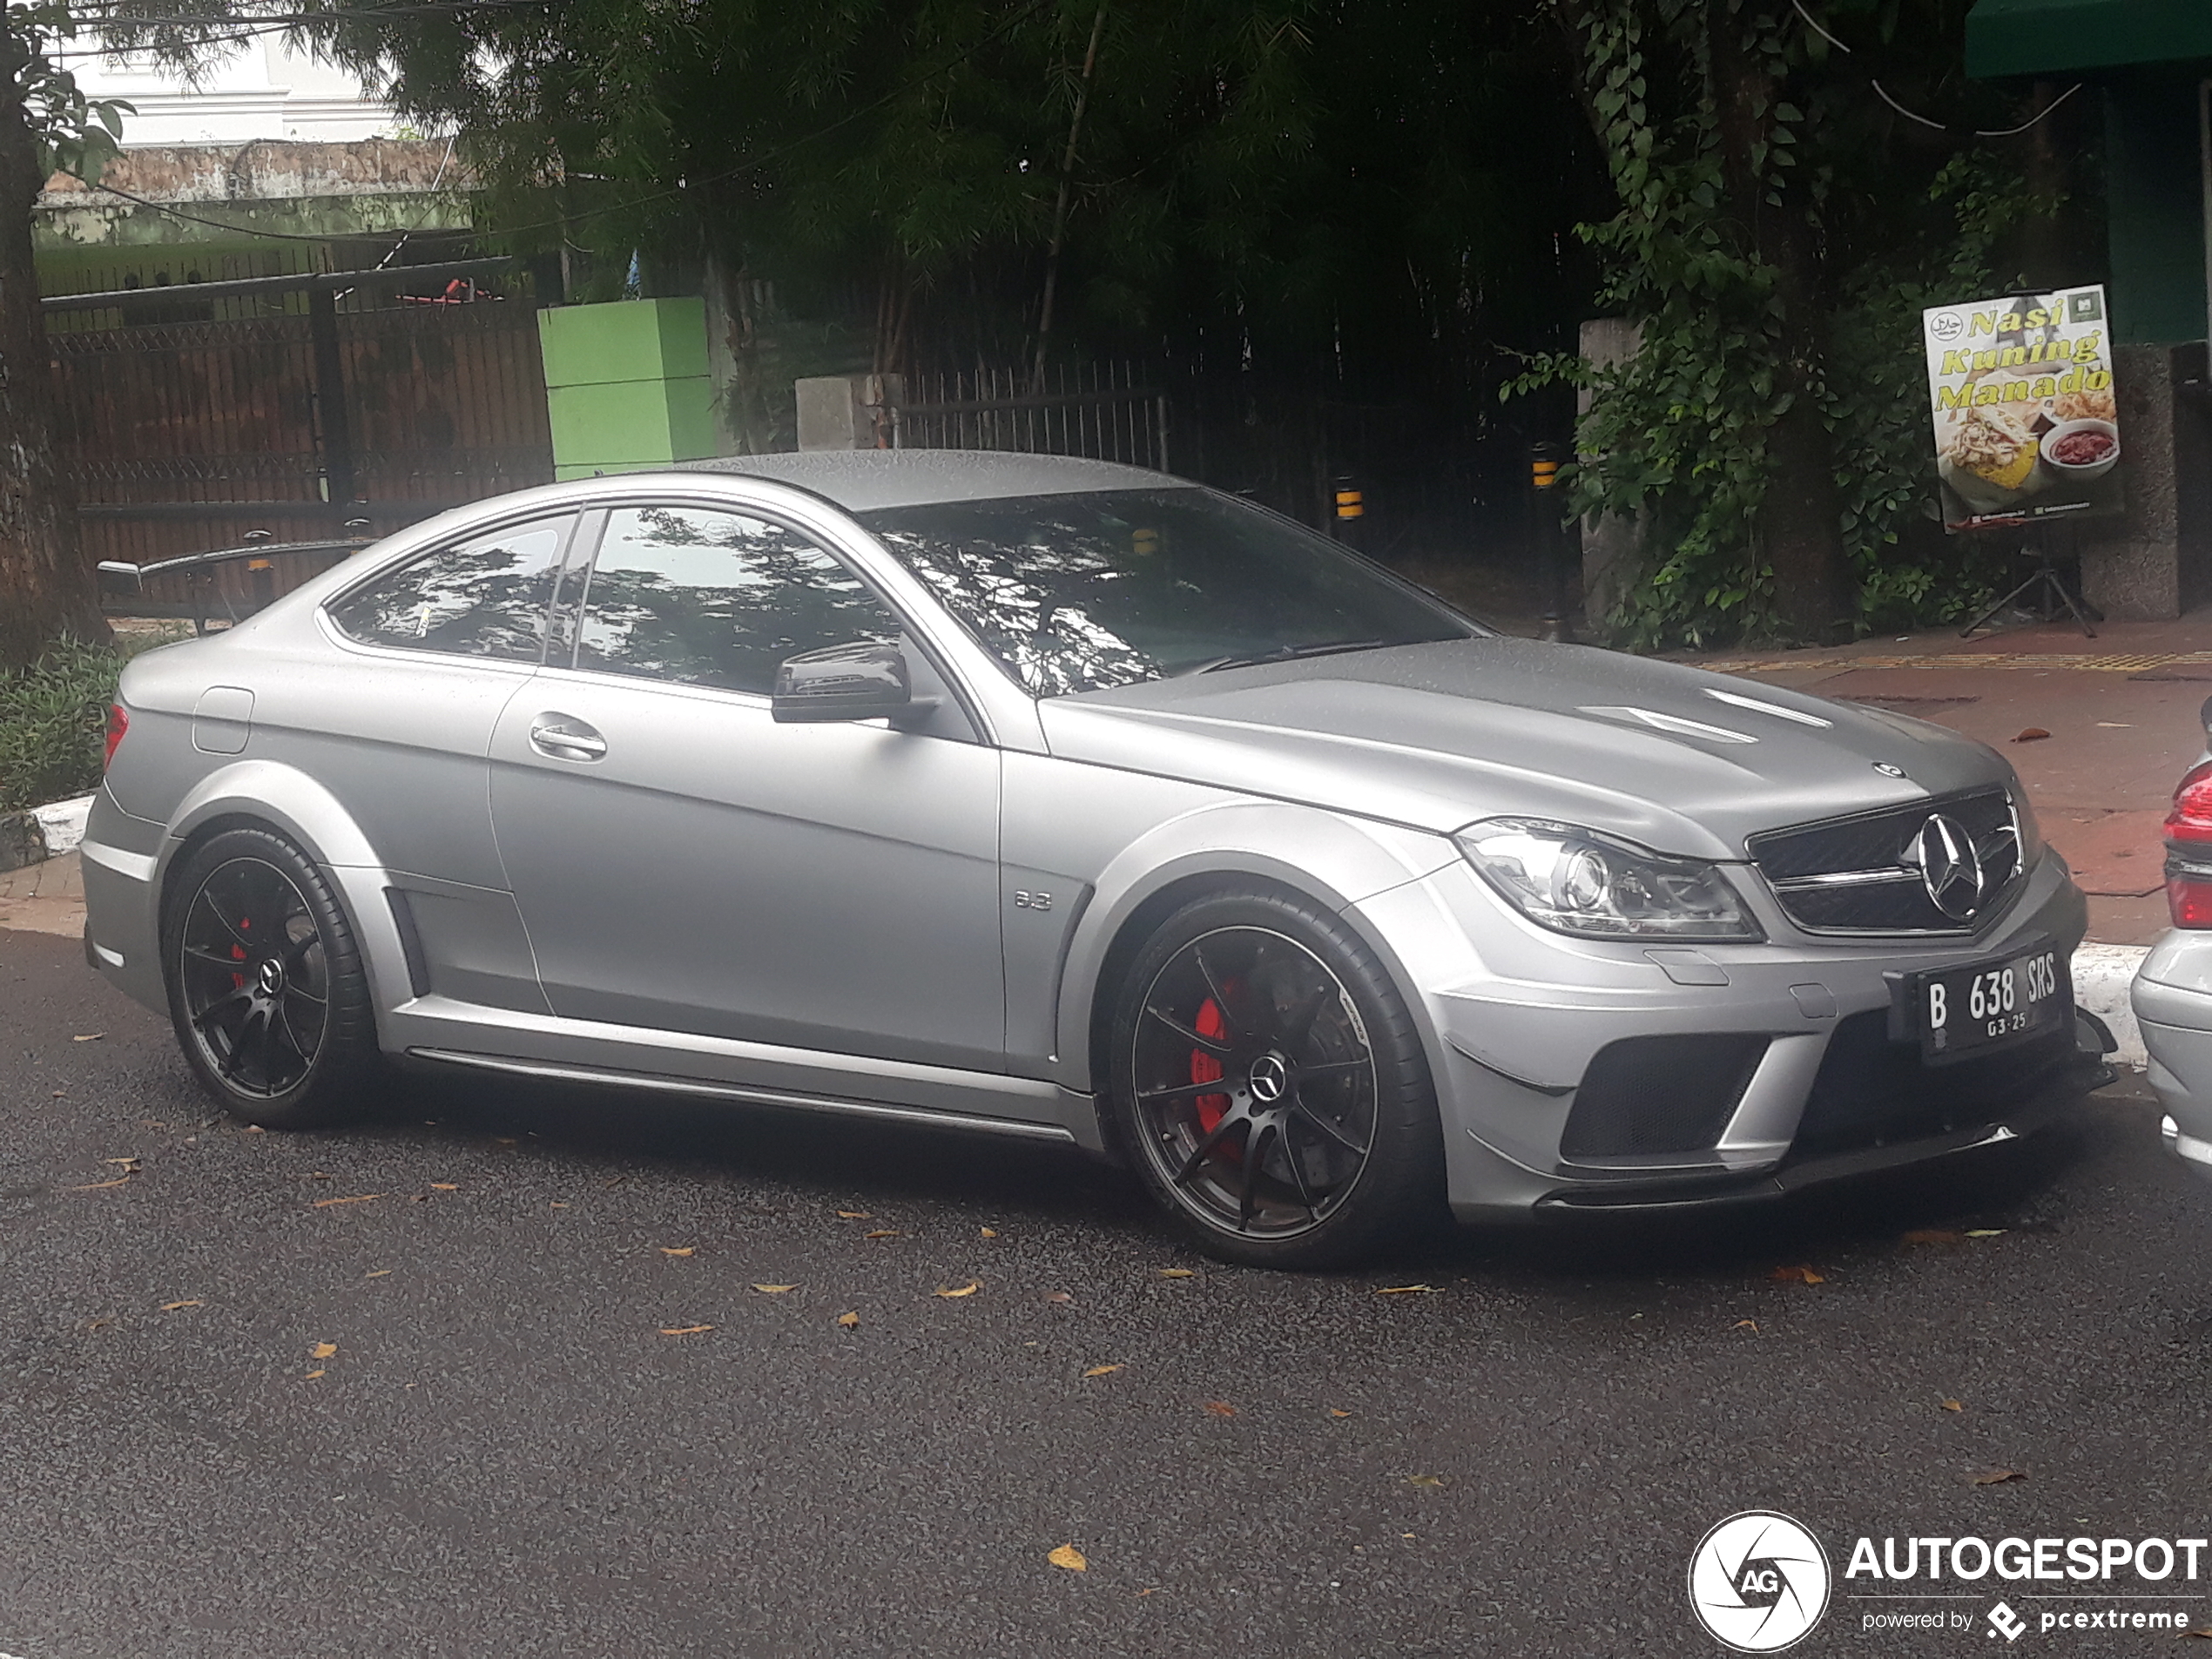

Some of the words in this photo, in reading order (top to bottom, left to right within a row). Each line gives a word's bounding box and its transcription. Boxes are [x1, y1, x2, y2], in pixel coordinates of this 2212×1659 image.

[1968, 298, 2065, 337] Nasi
[1939, 329, 2101, 375] Kuning
[1934, 366, 2113, 412] Manado
[1929, 983, 1946, 1028] B
[1970, 968, 2014, 1019] 638
[2027, 952, 2055, 1002] SRS
